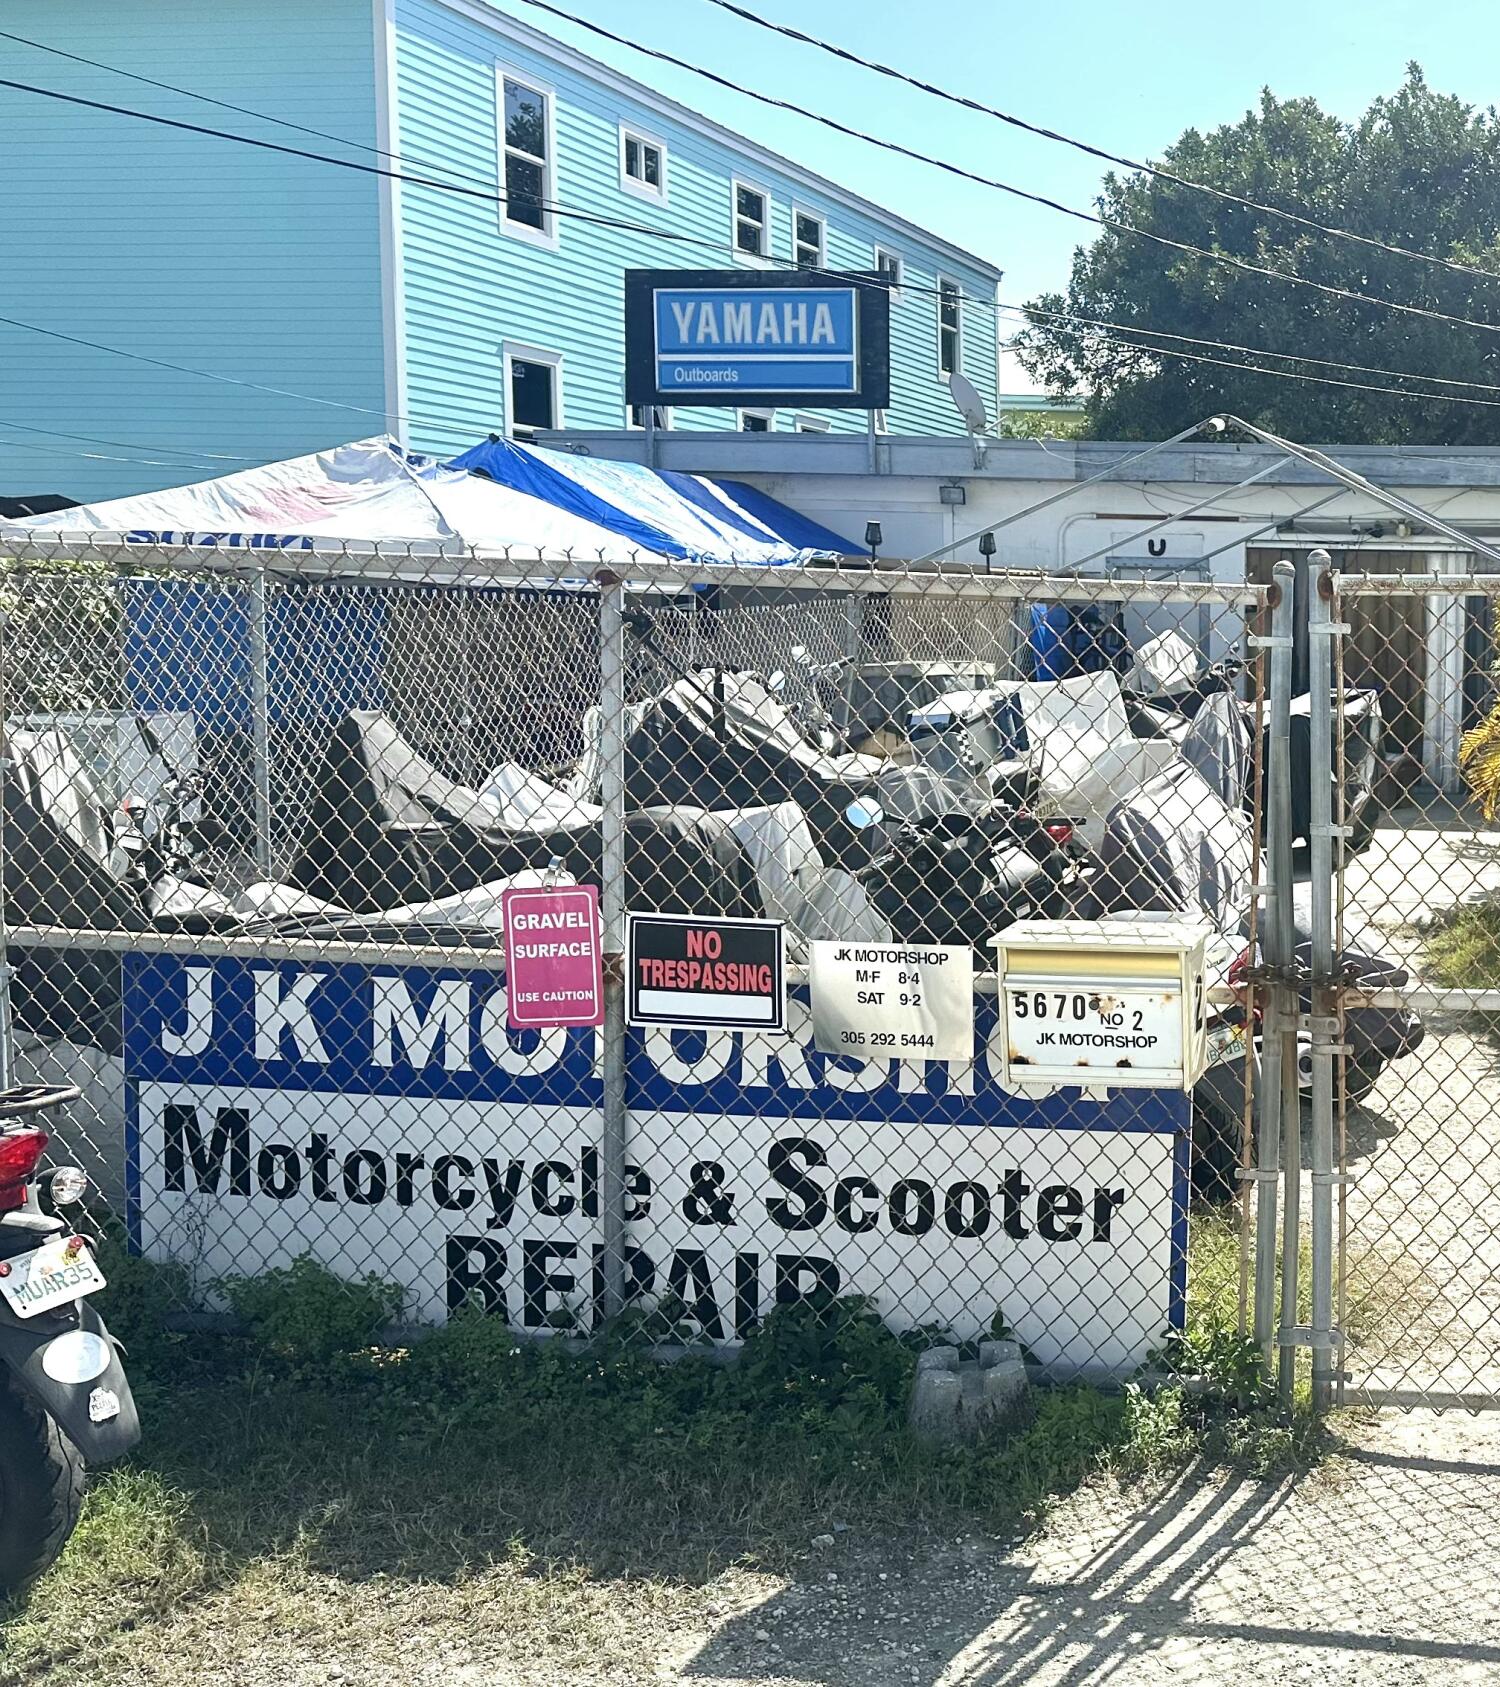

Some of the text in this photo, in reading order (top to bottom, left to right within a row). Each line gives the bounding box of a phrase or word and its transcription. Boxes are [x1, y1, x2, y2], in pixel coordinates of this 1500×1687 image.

[670, 302, 836, 344] YAMAHA
[674, 367, 739, 383] Outboards
[513, 911, 590, 931] GRAVEL
[514, 941, 592, 959] SURFACE
[686, 929, 723, 959] NO
[834, 948, 949, 966] JK MOTORSHOP
[638, 958, 773, 993] TRESPASSING
[517, 989, 594, 1002] USE CAUTION
[857, 991, 886, 1005] SAT
[1100, 1010, 1144, 1032] NO 2
[841, 1031, 935, 1047] 305 292 5444
[1036, 1032, 1158, 1049] JK MOTORSHOP
[163, 1102, 1124, 1243] Motorcycle & Scooter
